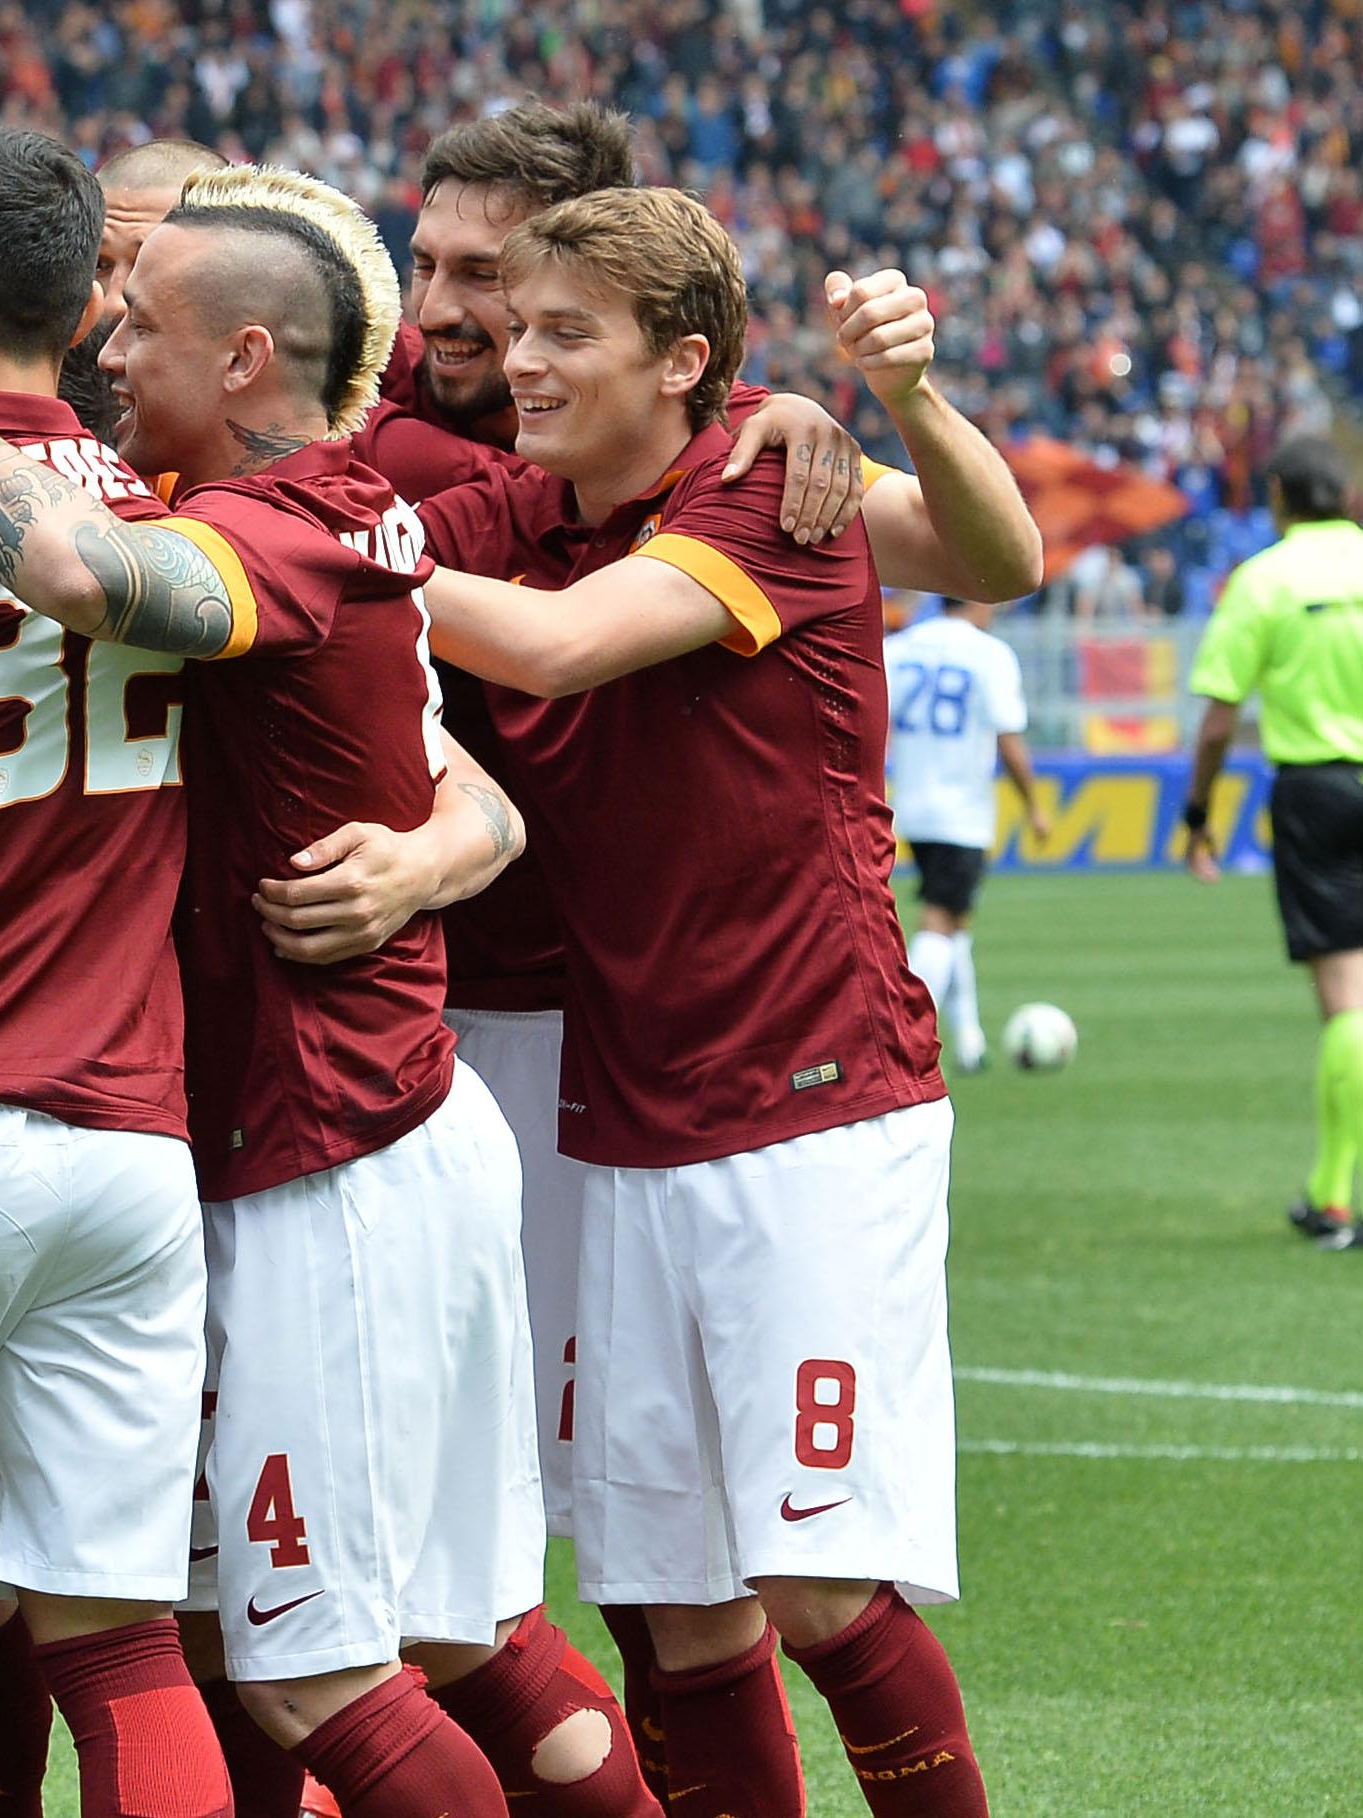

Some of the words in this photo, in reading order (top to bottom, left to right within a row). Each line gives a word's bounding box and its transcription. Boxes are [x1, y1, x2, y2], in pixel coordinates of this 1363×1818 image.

[894, 663, 973, 737] 28
[794, 1358, 856, 1470] 8
[246, 1453, 311, 1568] 4
